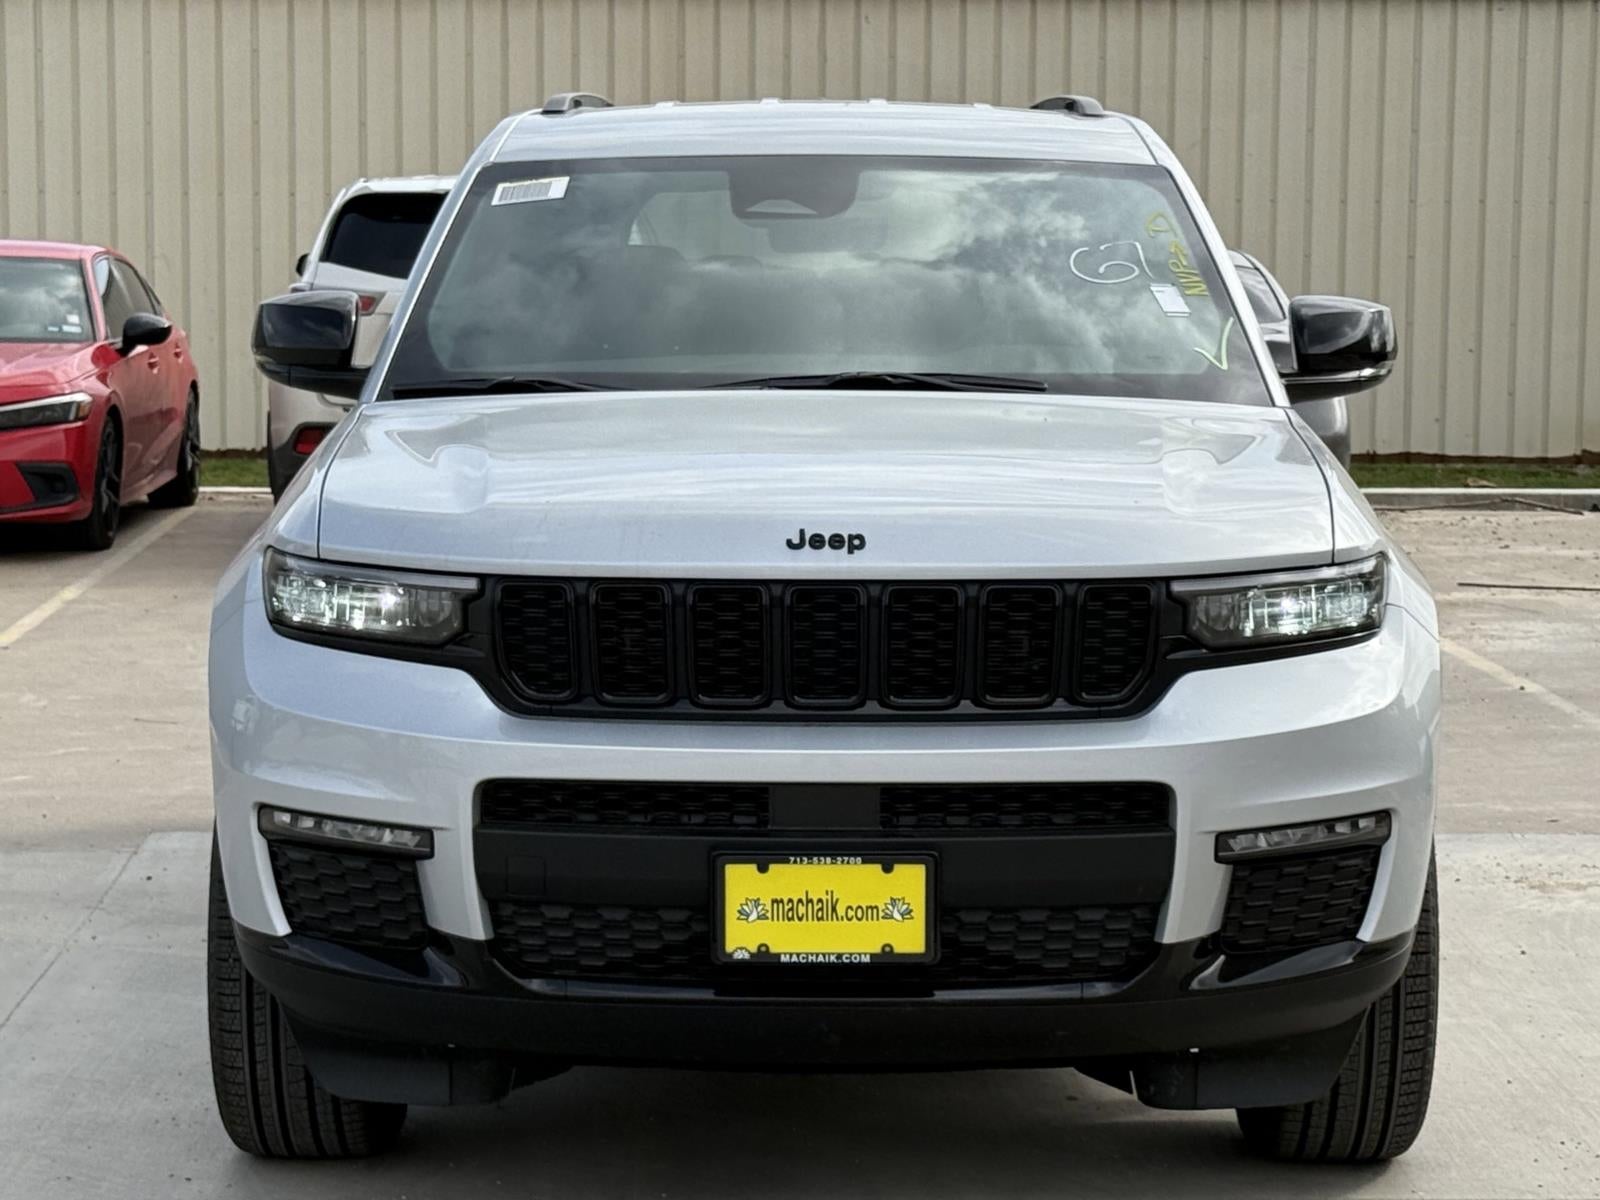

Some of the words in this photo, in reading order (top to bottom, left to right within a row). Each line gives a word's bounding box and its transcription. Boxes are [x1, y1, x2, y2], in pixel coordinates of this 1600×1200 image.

[785, 528, 867, 555] Jeep
[770, 890, 880, 923] machaik.com
[780, 953, 871, 963] MACHAIK.COM
